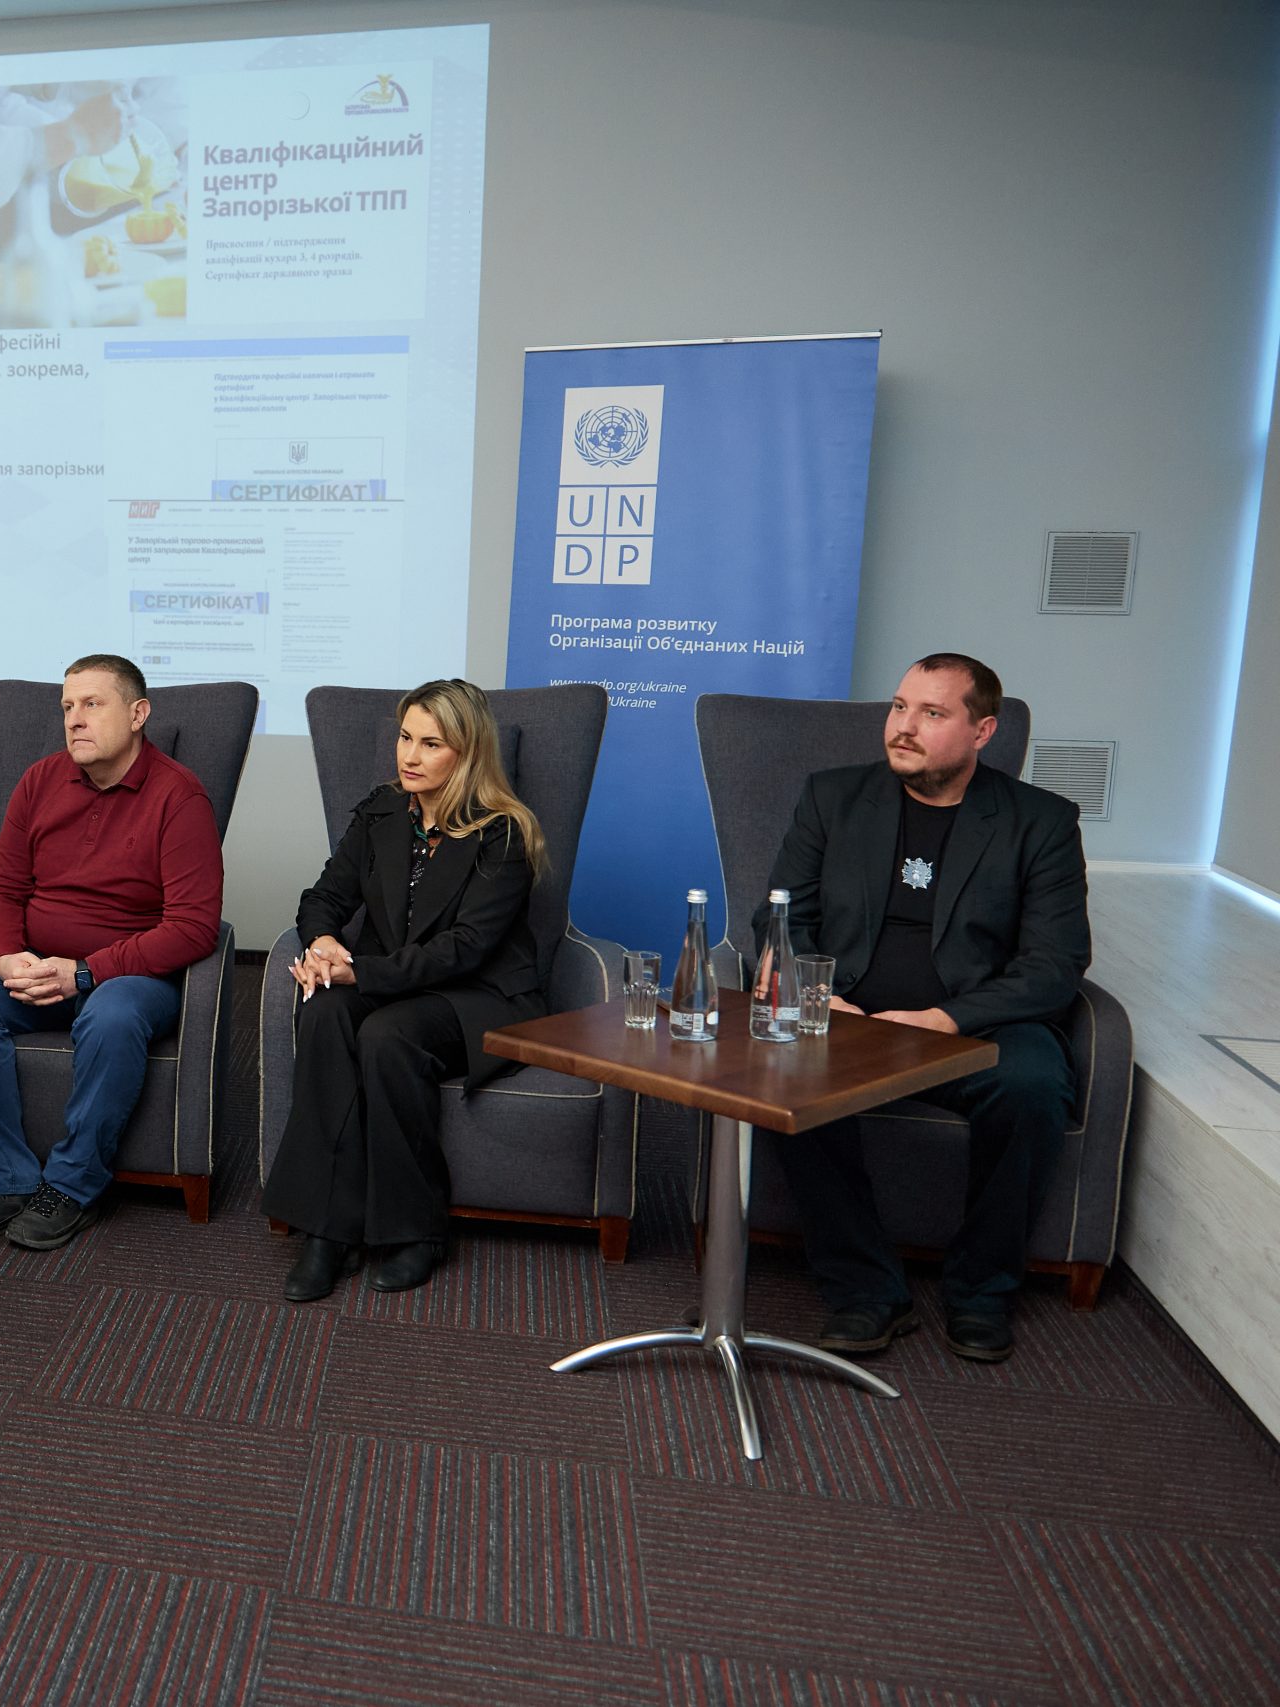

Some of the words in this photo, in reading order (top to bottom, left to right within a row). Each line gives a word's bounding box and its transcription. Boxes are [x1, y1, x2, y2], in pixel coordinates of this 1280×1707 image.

[204, 133, 423, 168] Кваліфікаційний
[204, 173, 277, 196] центр
[203, 191, 353, 221] Запорізької
[356, 190, 407, 211] ТПП
[7, 364, 89, 380] зокрема,
[229, 483, 367, 502] СЕРТИФІКАТ
[143, 594, 255, 611] СЕРТИФІКАТ
[551, 614, 631, 632] Програма
[637, 619, 717, 635] розвитку
[550, 634, 643, 652] Організації
[753, 640, 804, 657] Націй
